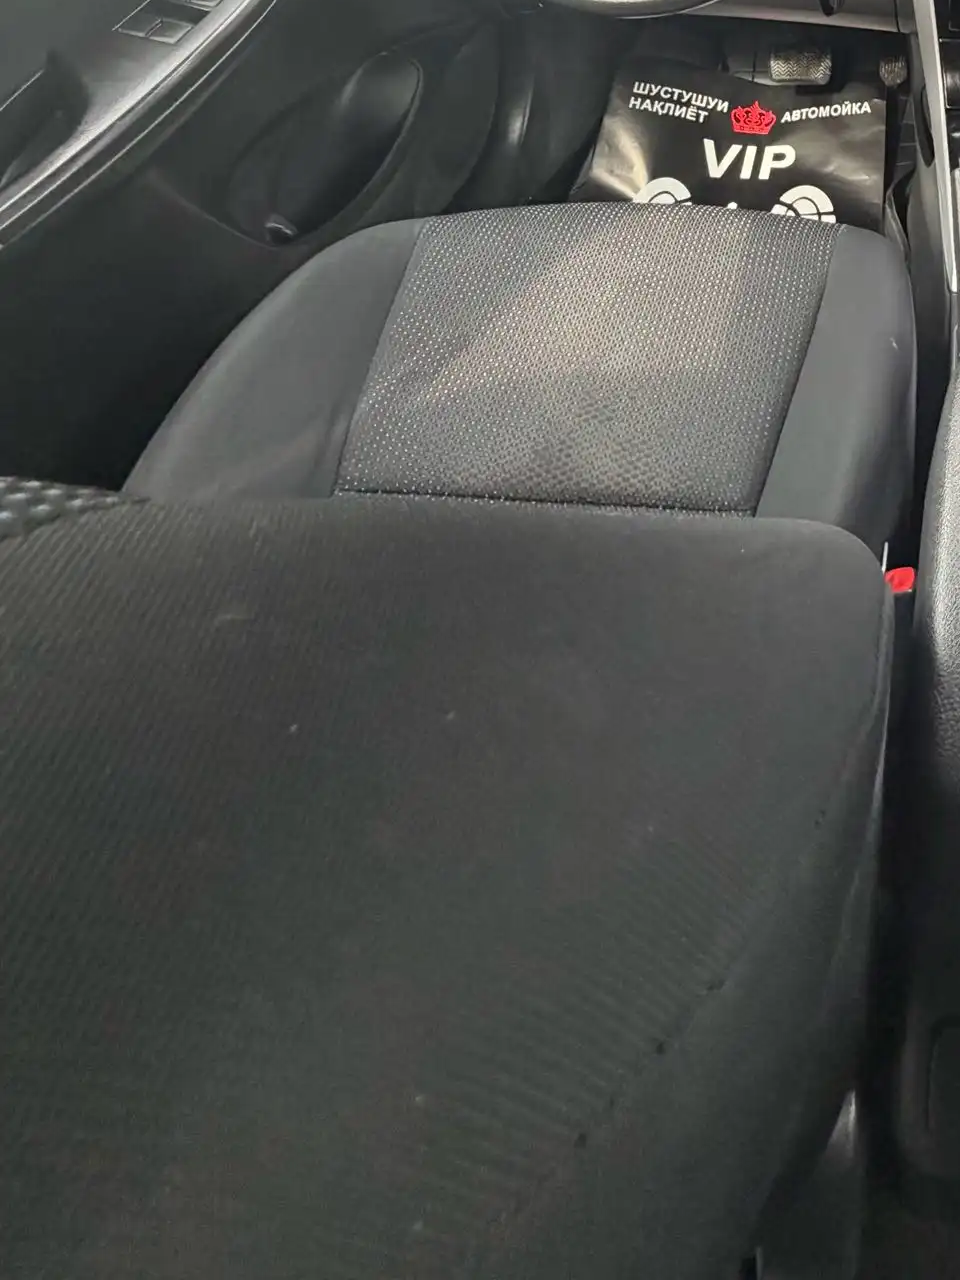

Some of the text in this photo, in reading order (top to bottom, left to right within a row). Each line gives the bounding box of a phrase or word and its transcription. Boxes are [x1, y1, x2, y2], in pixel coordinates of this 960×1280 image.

[632, 81, 729, 113] ШУСТУШУИ
[780, 100, 872, 124] АВТОМОЙКА
[703, 138, 797, 180] VIP
